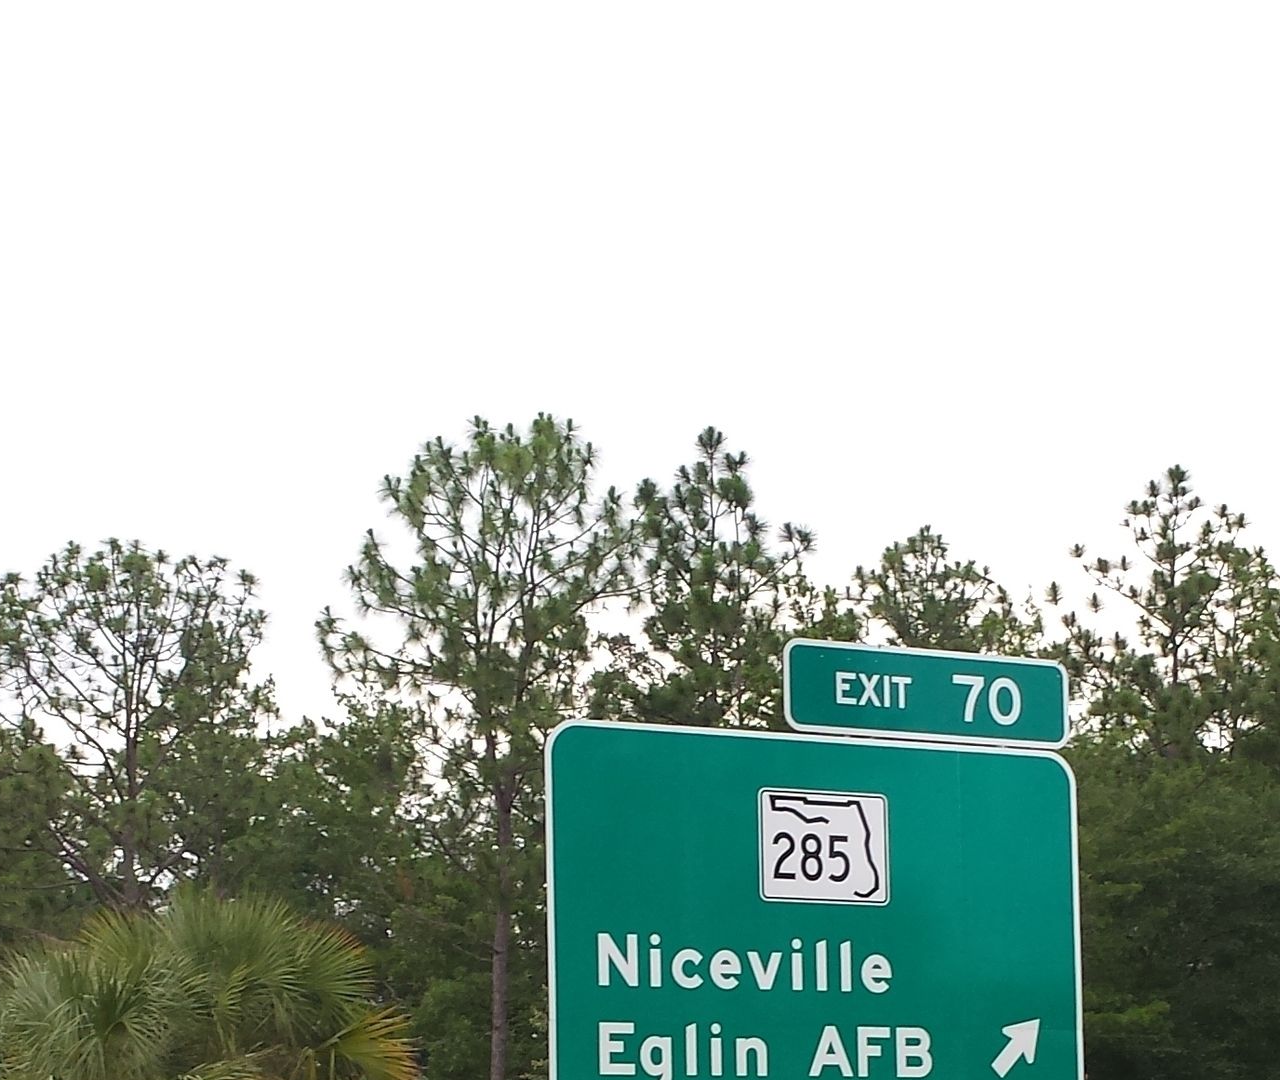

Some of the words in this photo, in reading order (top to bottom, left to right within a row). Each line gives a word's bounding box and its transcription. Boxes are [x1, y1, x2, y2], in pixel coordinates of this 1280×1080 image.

[835, 672, 912, 709] EXIT
[952, 675, 1022, 725] 70
[772, 832, 850, 881] 285
[597, 933, 893, 994] Niceville
[808, 1025, 933, 1078] AFB
